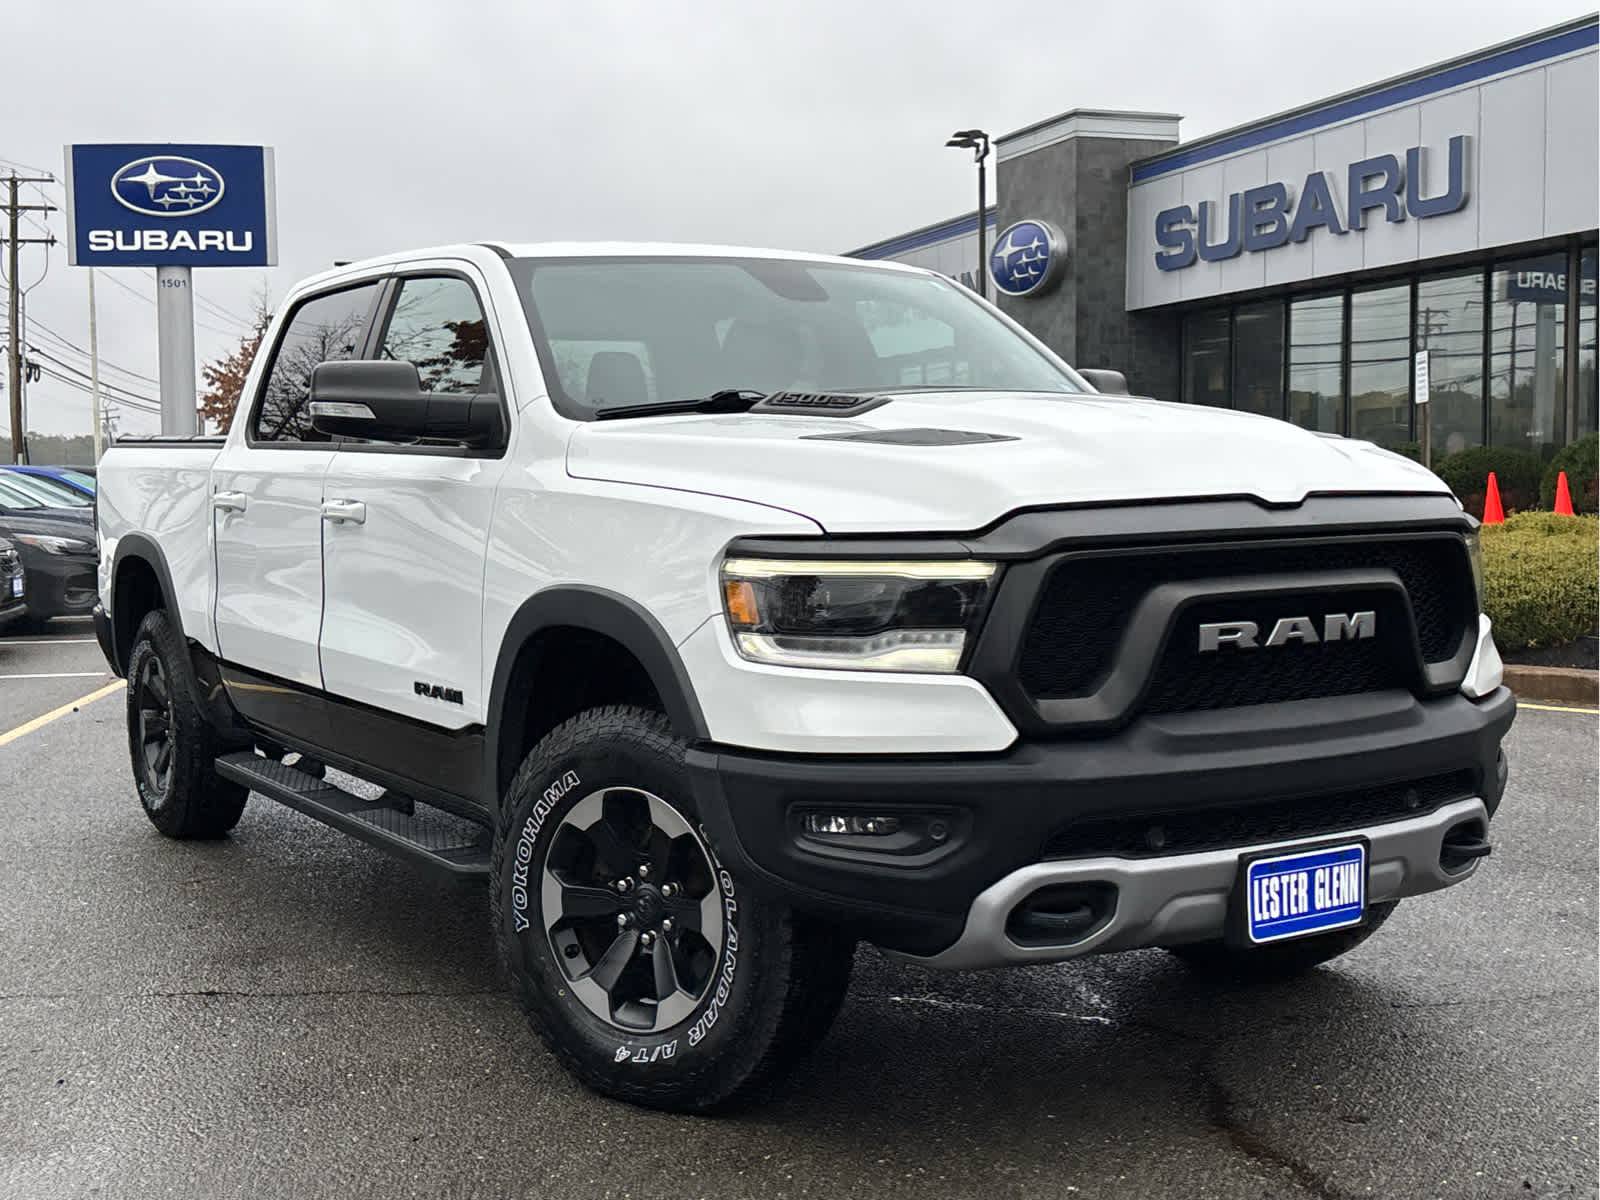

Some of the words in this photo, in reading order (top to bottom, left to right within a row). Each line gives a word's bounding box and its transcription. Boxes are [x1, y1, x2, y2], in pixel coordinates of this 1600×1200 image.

[1155, 135, 1473, 272] SUBARU
[88, 230, 253, 251] SUBARU
[161, 279, 187, 288] 1501
[1199, 611, 1376, 652] RAM
[414, 681, 464, 705] RAM
[512, 770, 581, 933] YOKOHAMA
[1254, 871, 1309, 922] LESTER
[1314, 862, 1360, 910] GLENN
[688, 824, 739, 1047] OLANDAR
[614, 1040, 678, 1062] A/T4
